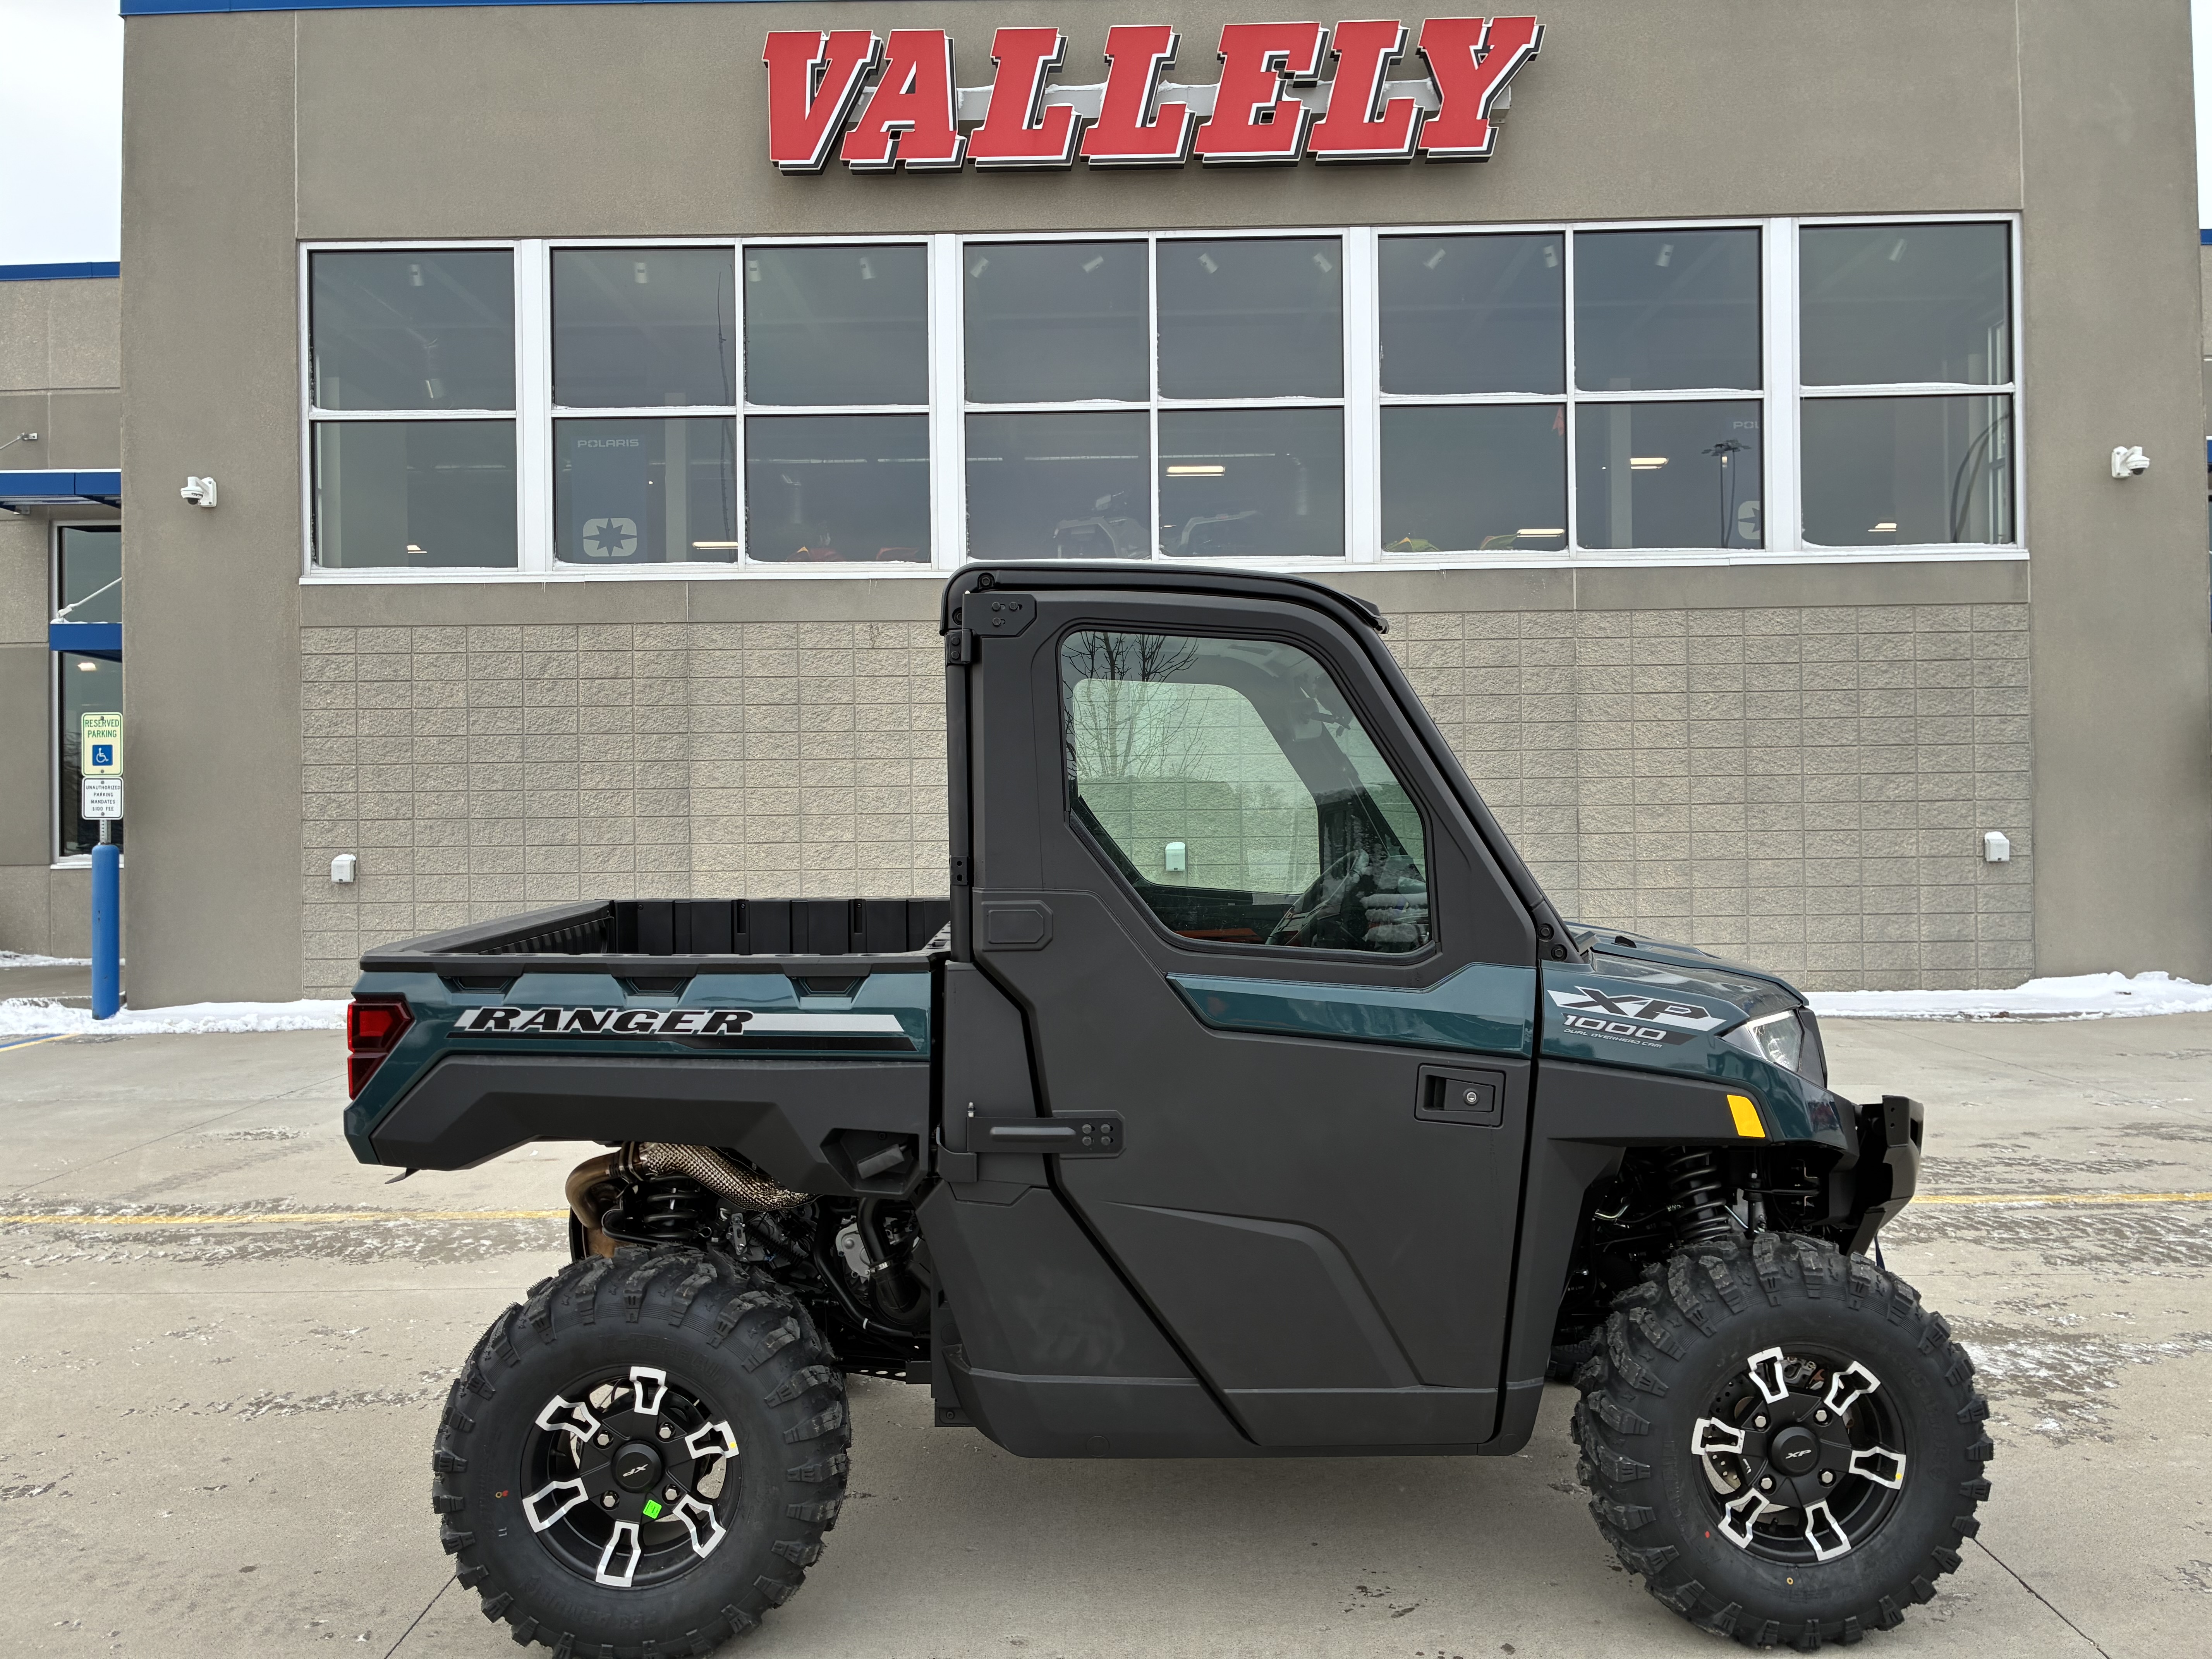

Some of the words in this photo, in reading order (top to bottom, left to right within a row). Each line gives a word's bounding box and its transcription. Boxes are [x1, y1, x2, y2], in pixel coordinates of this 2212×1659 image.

[762, 16, 1546, 175] VALLELY
[577, 439, 639, 448] POLARIS
[85, 719, 119, 727] RESERVED
[1558, 986, 1712, 1020] XP
[465, 1006, 754, 1035] RANGER
[1563, 1015, 1667, 1041] 1000
[1591, 1033, 1641, 1044] OVERHEAD
[1785, 1449, 1812, 1459] XP
[623, 1464, 648, 1477] XP
